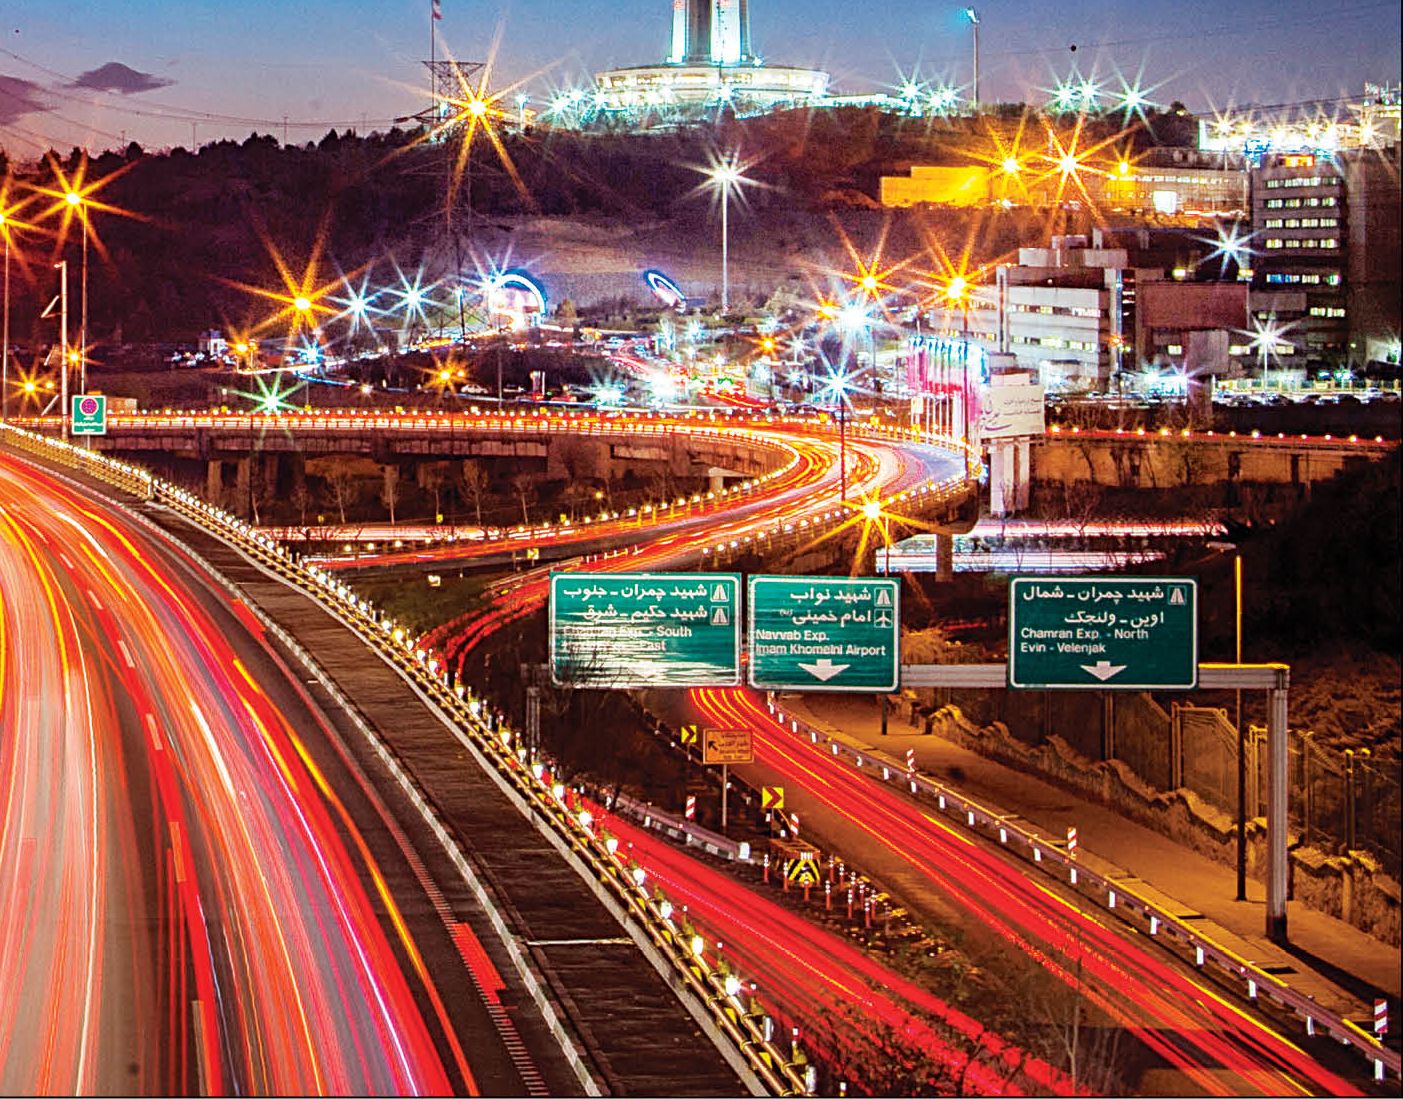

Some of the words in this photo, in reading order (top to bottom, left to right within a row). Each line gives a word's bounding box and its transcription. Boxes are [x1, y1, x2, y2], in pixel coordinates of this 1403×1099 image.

[621, 584, 666, 601] چمران
[670, 584, 708, 598] شهید
[790, 587, 830, 606] نواب
[834, 587, 871, 603] شهید
[1023, 585, 1064, 601] شمال
[1077, 586, 1124, 605] چمران
[1127, 586, 1164, 601] شهید
[631, 605, 666, 623] حکیم
[670, 605, 708, 621] شهید
[792, 610, 838, 625] خمینی
[840, 610, 871, 628] امام
[1064, 611, 1116, 626] ولنجک
[1130, 611, 1164, 628] اوین
[656, 626, 692, 638] South
[756, 629, 801, 641] Navvab
[803, 630, 830, 642] Exp.
[1020, 627, 1073, 639] Chamran
[1114, 628, 1149, 639] North
[756, 644, 787, 655] Imam
[789, 644, 843, 655] Khomeini
[846, 645, 886, 657] Airport
[1020, 642, 1047, 653] Evin
[1056, 642, 1106, 655] Velenjak
